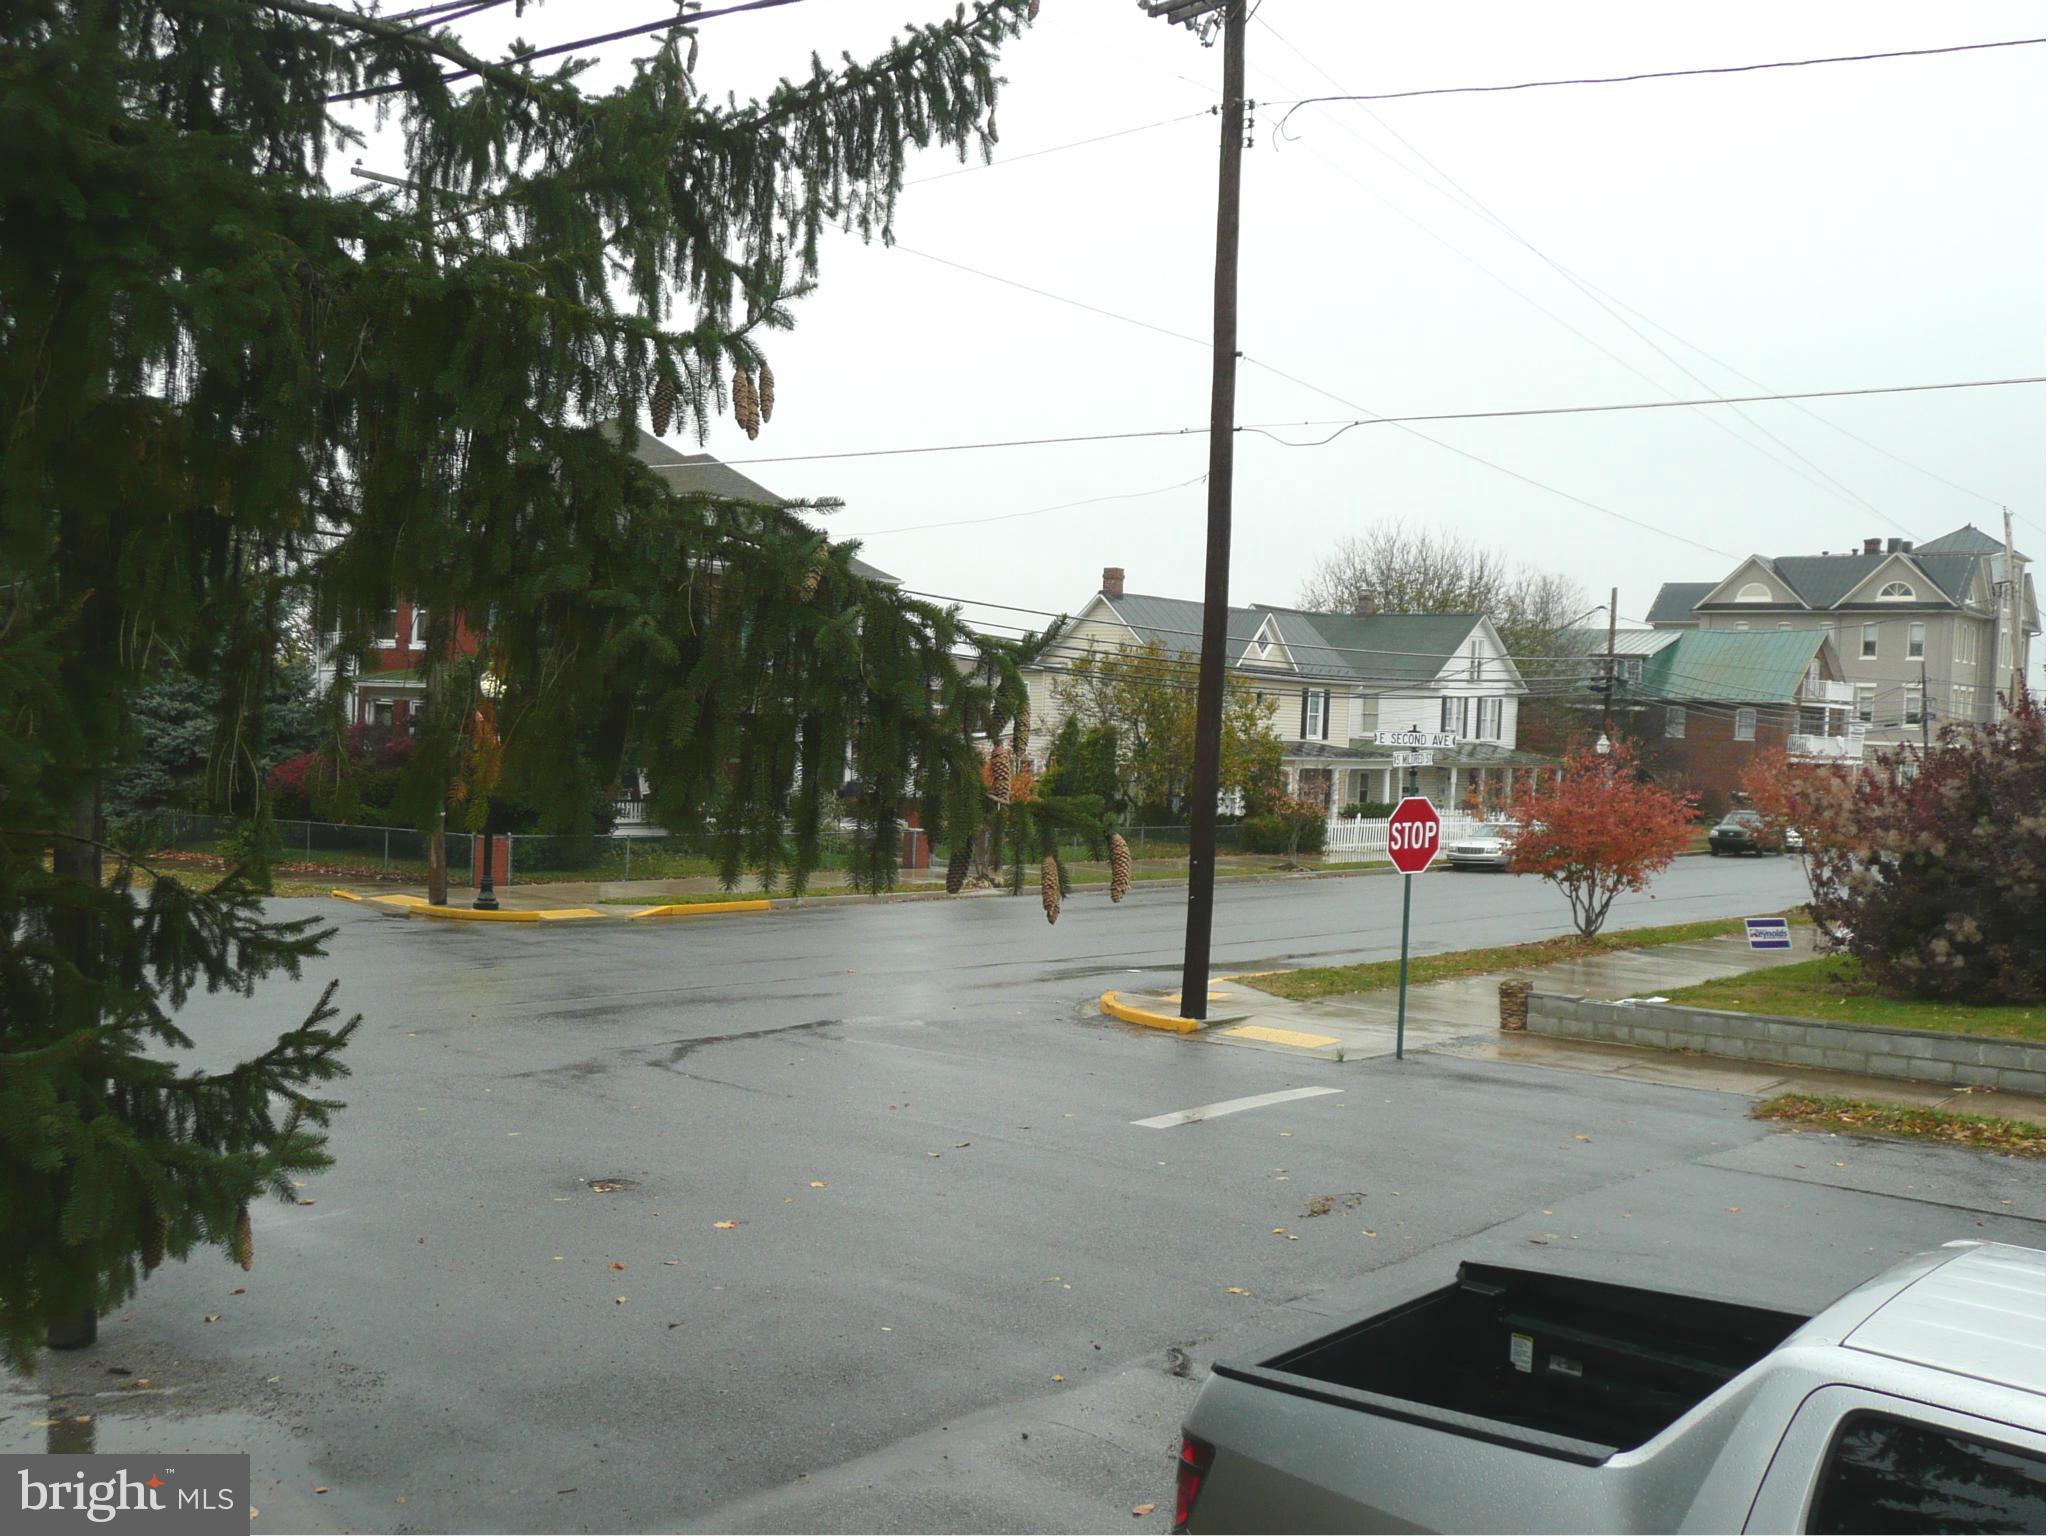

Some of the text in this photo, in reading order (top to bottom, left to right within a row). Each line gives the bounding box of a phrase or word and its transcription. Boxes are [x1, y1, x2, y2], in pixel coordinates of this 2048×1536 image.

[1380, 732, 1450, 747] E SECOND AVE
[1390, 821, 1437, 850] STOP
